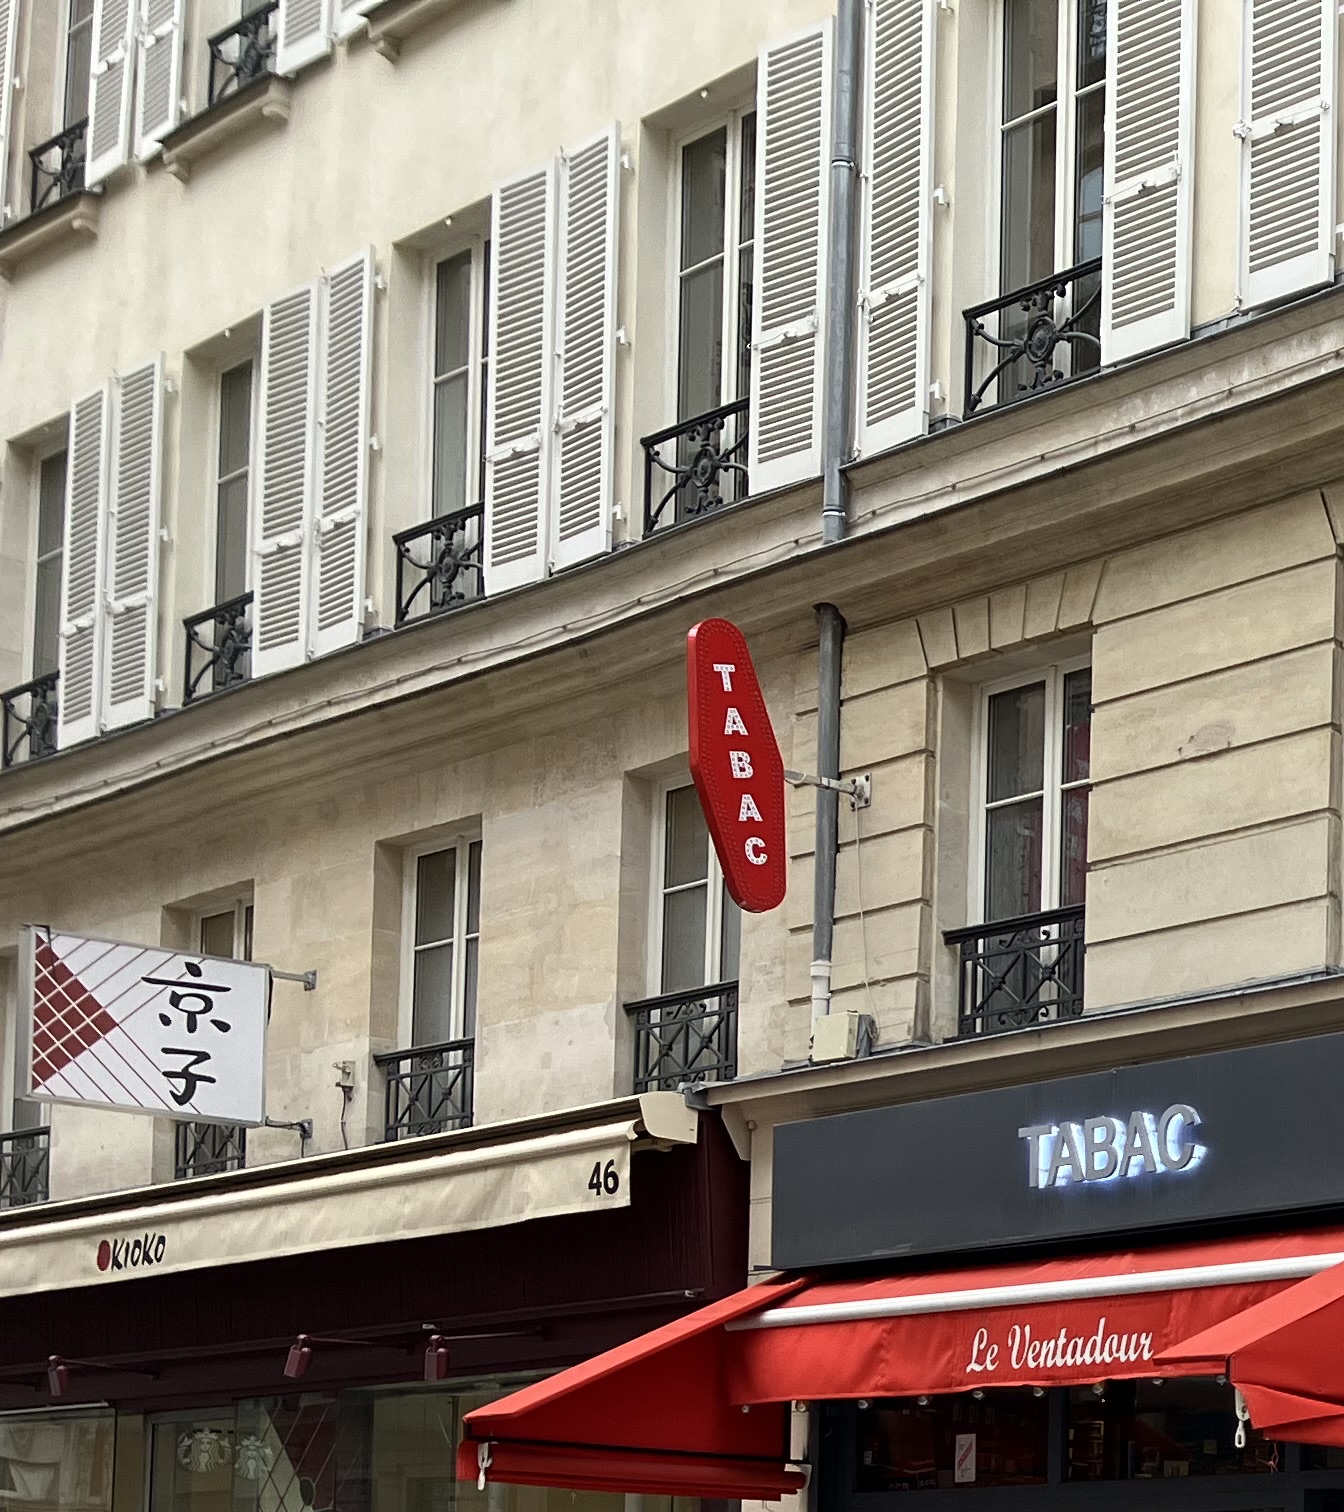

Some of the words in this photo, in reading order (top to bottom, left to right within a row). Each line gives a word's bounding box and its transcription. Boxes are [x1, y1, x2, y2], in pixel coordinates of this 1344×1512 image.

[713, 664, 767, 865] TABAC
[141, 962, 233, 1106] 京子
[588, 1159, 620, 1196] 46
[1017, 1103, 1205, 1189] TABAC
[110, 1232, 167, 1273] KIOKO
[966, 1327, 999, 1373] Le
[1008, 1317, 1154, 1370] Ventadour
